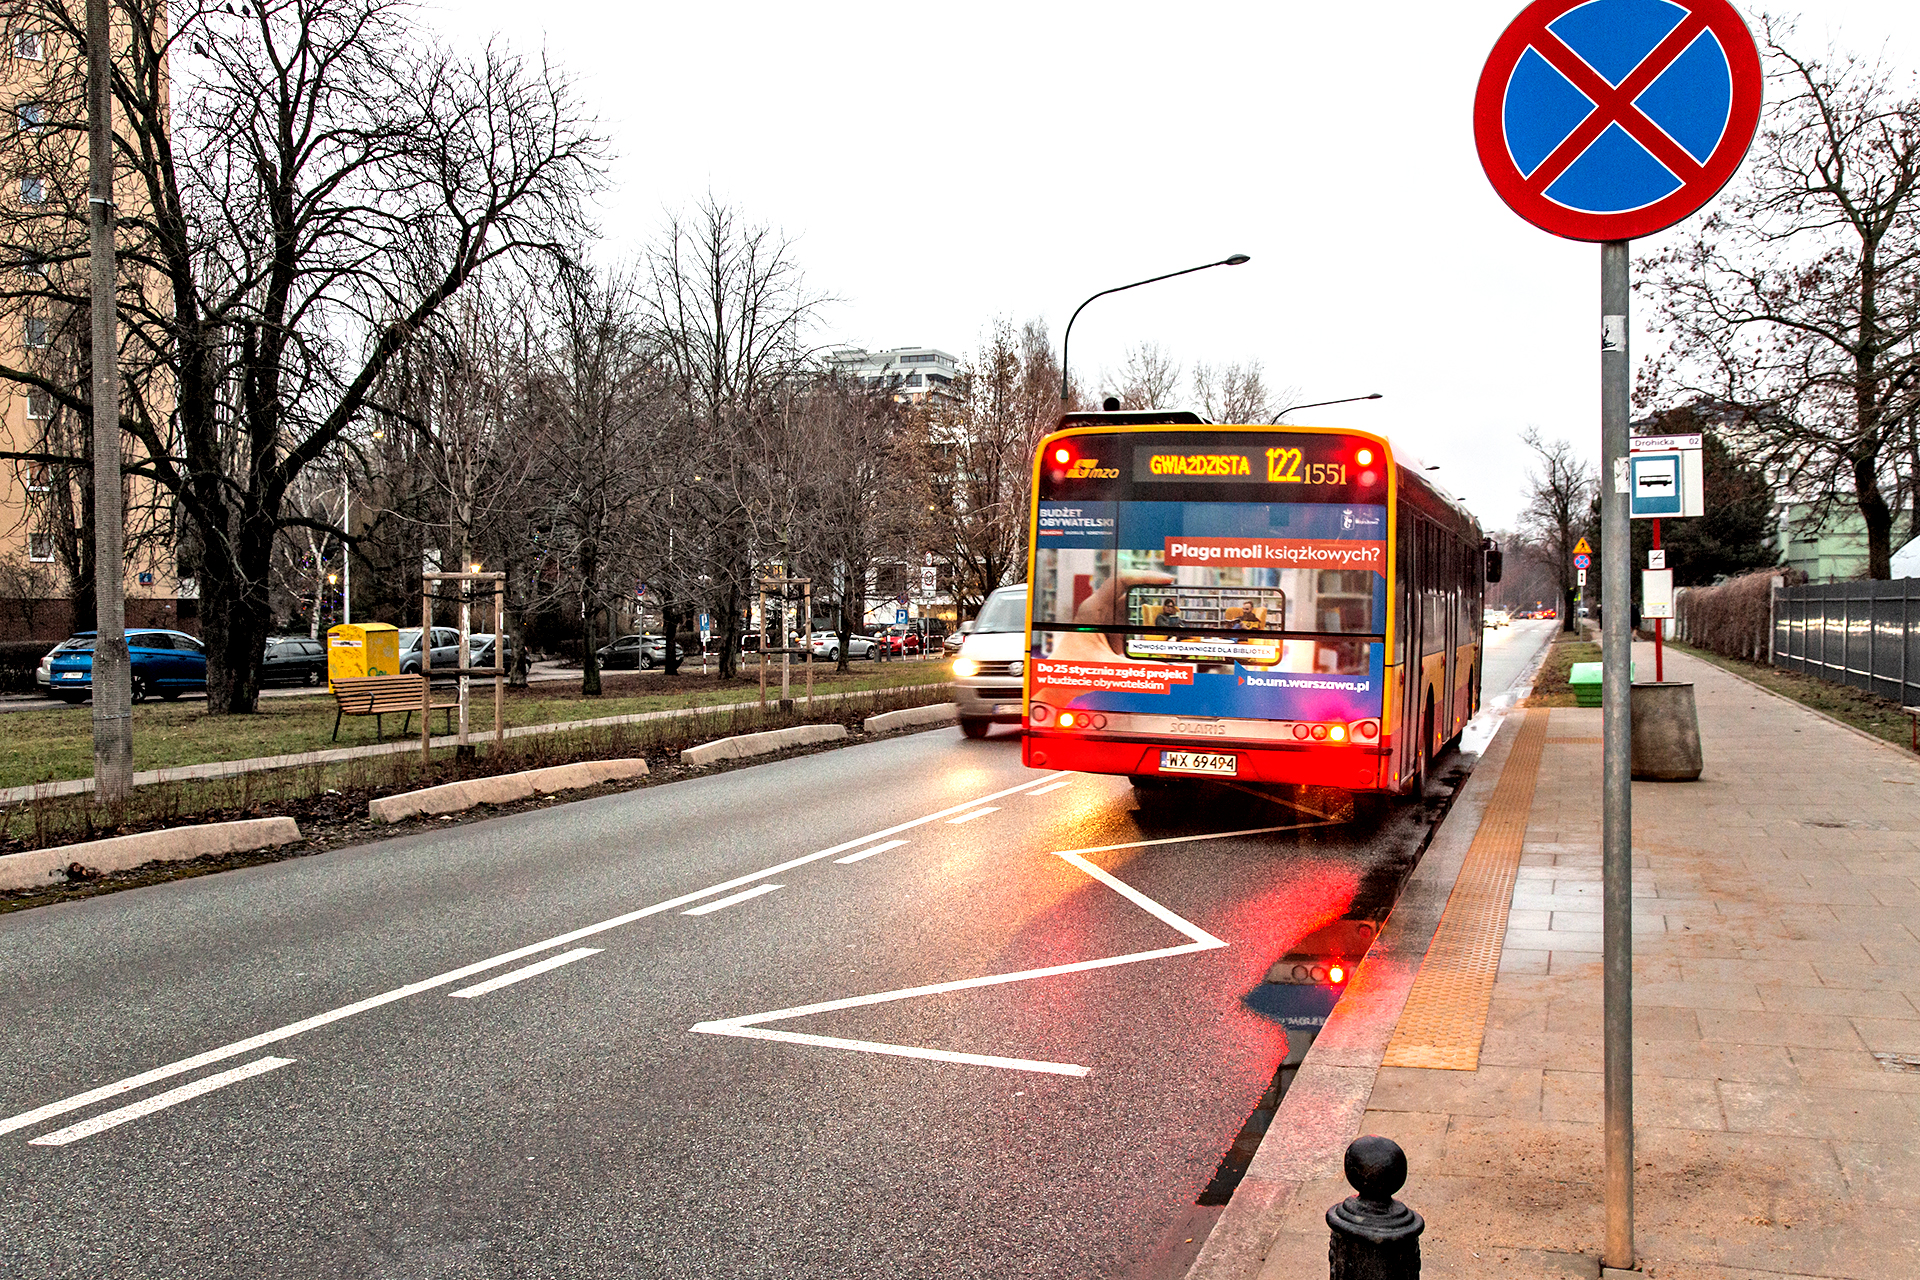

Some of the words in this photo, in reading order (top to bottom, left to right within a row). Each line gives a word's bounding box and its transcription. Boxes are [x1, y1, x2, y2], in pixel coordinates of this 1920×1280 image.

[1635, 439, 1675, 447] Drohicka
[1265, 447, 1303, 483] 122
[1303, 463, 1347, 485] 1551
[1039, 507, 1083, 518] BUDŻET
[1039, 518, 1115, 527] OBYWATELSKI
[1170, 543, 1221, 561] Plaga
[1224, 544, 1263, 559] moli
[1265, 546, 1381, 564] książkowych?
[1132, 643, 1166, 651] NOWOŚCI
[1167, 645, 1216, 653] WYDAWNICZE
[1233, 647, 1271, 655] BIBLIOTEK
[1037, 663, 1054, 673] Do
[1054, 664, 1068, 674] 25
[1069, 665, 1115, 678] stycznia
[1115, 667, 1146, 679] zgłoś
[1147, 669, 1188, 682] projekt
[1037, 676, 1046, 684] w
[1047, 675, 1092, 687] budżecie
[1093, 679, 1165, 691] obywatelskim
[1246, 676, 1370, 693] bo.um.warszawa.pl
[1170, 722, 1226, 735] SOLARIS
[1169, 753, 1188, 767] WX
[1193, 755, 1234, 770] 69494
